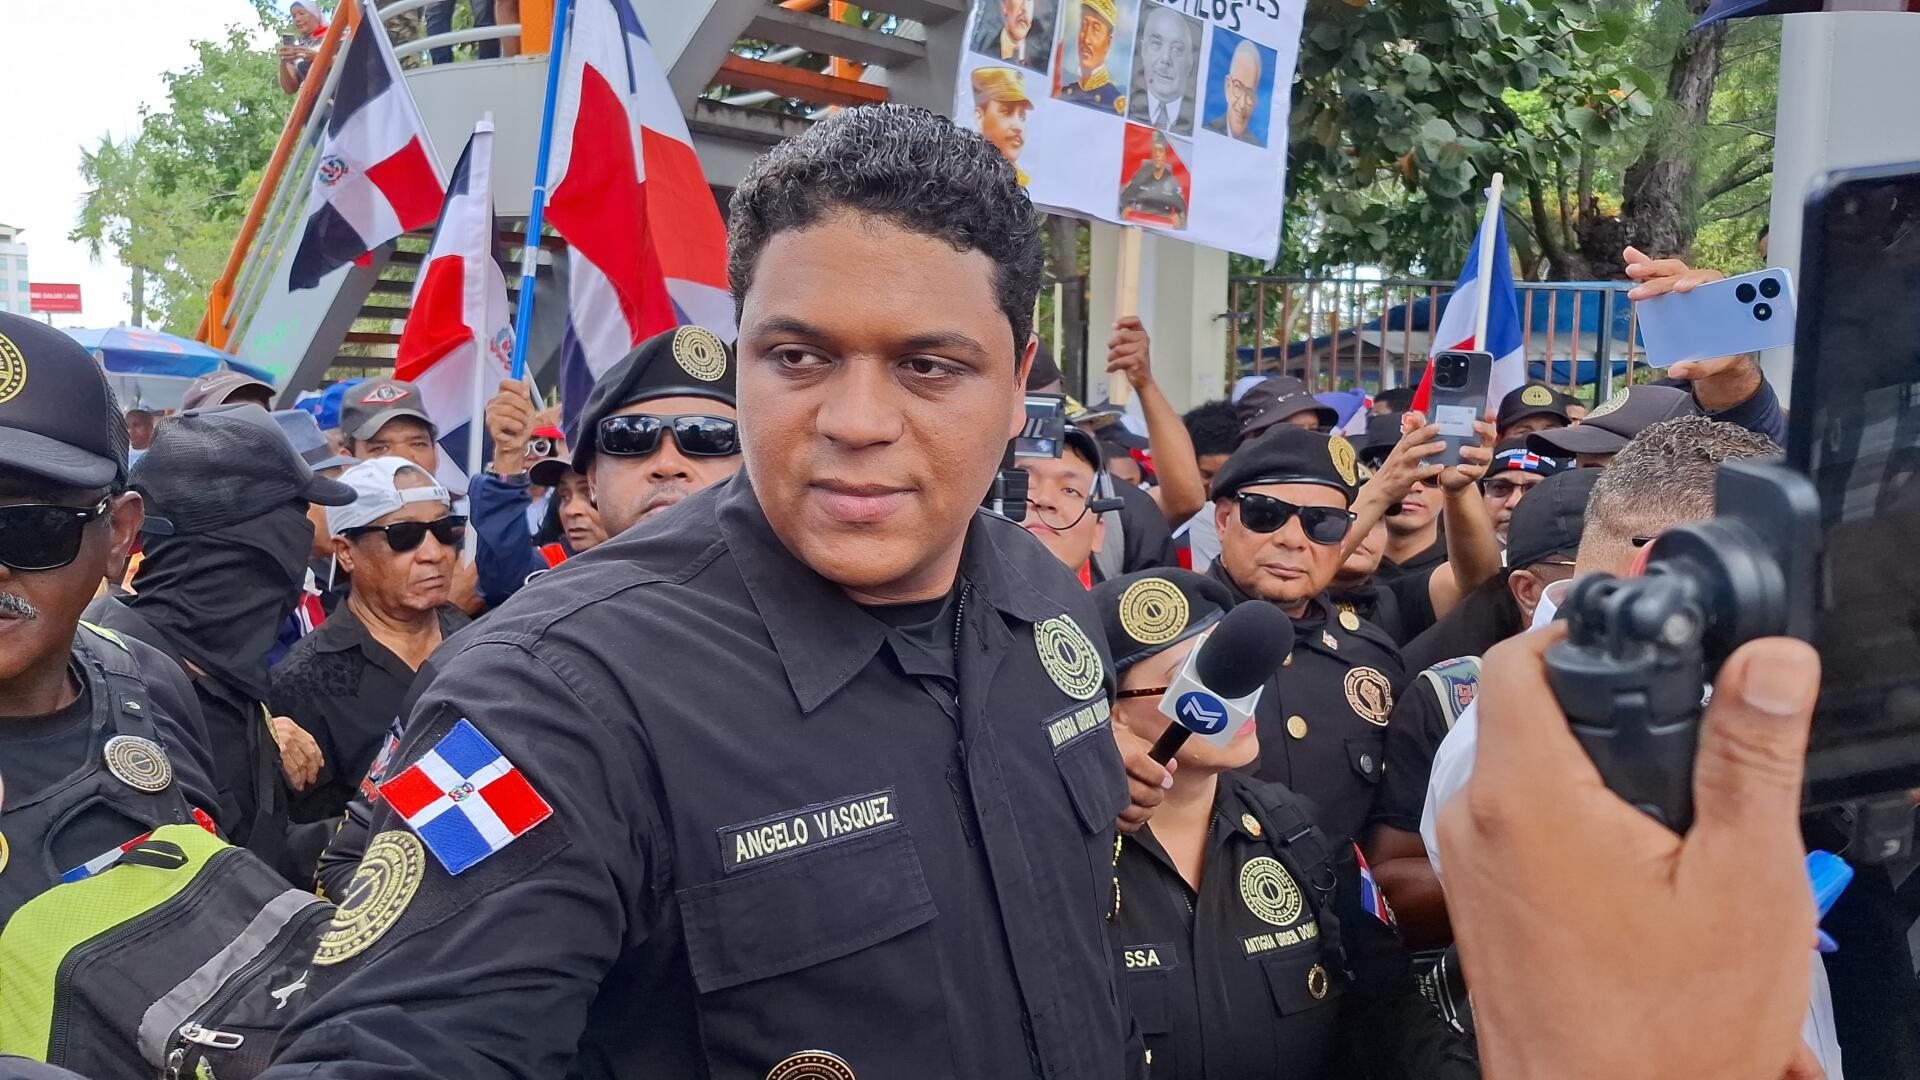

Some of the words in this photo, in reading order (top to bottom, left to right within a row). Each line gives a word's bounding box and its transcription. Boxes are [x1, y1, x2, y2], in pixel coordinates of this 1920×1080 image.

[736, 818, 809, 862] ANGELO
[814, 796, 894, 838] VASQUEZ
[1244, 933, 1277, 954] ANTIGUA
